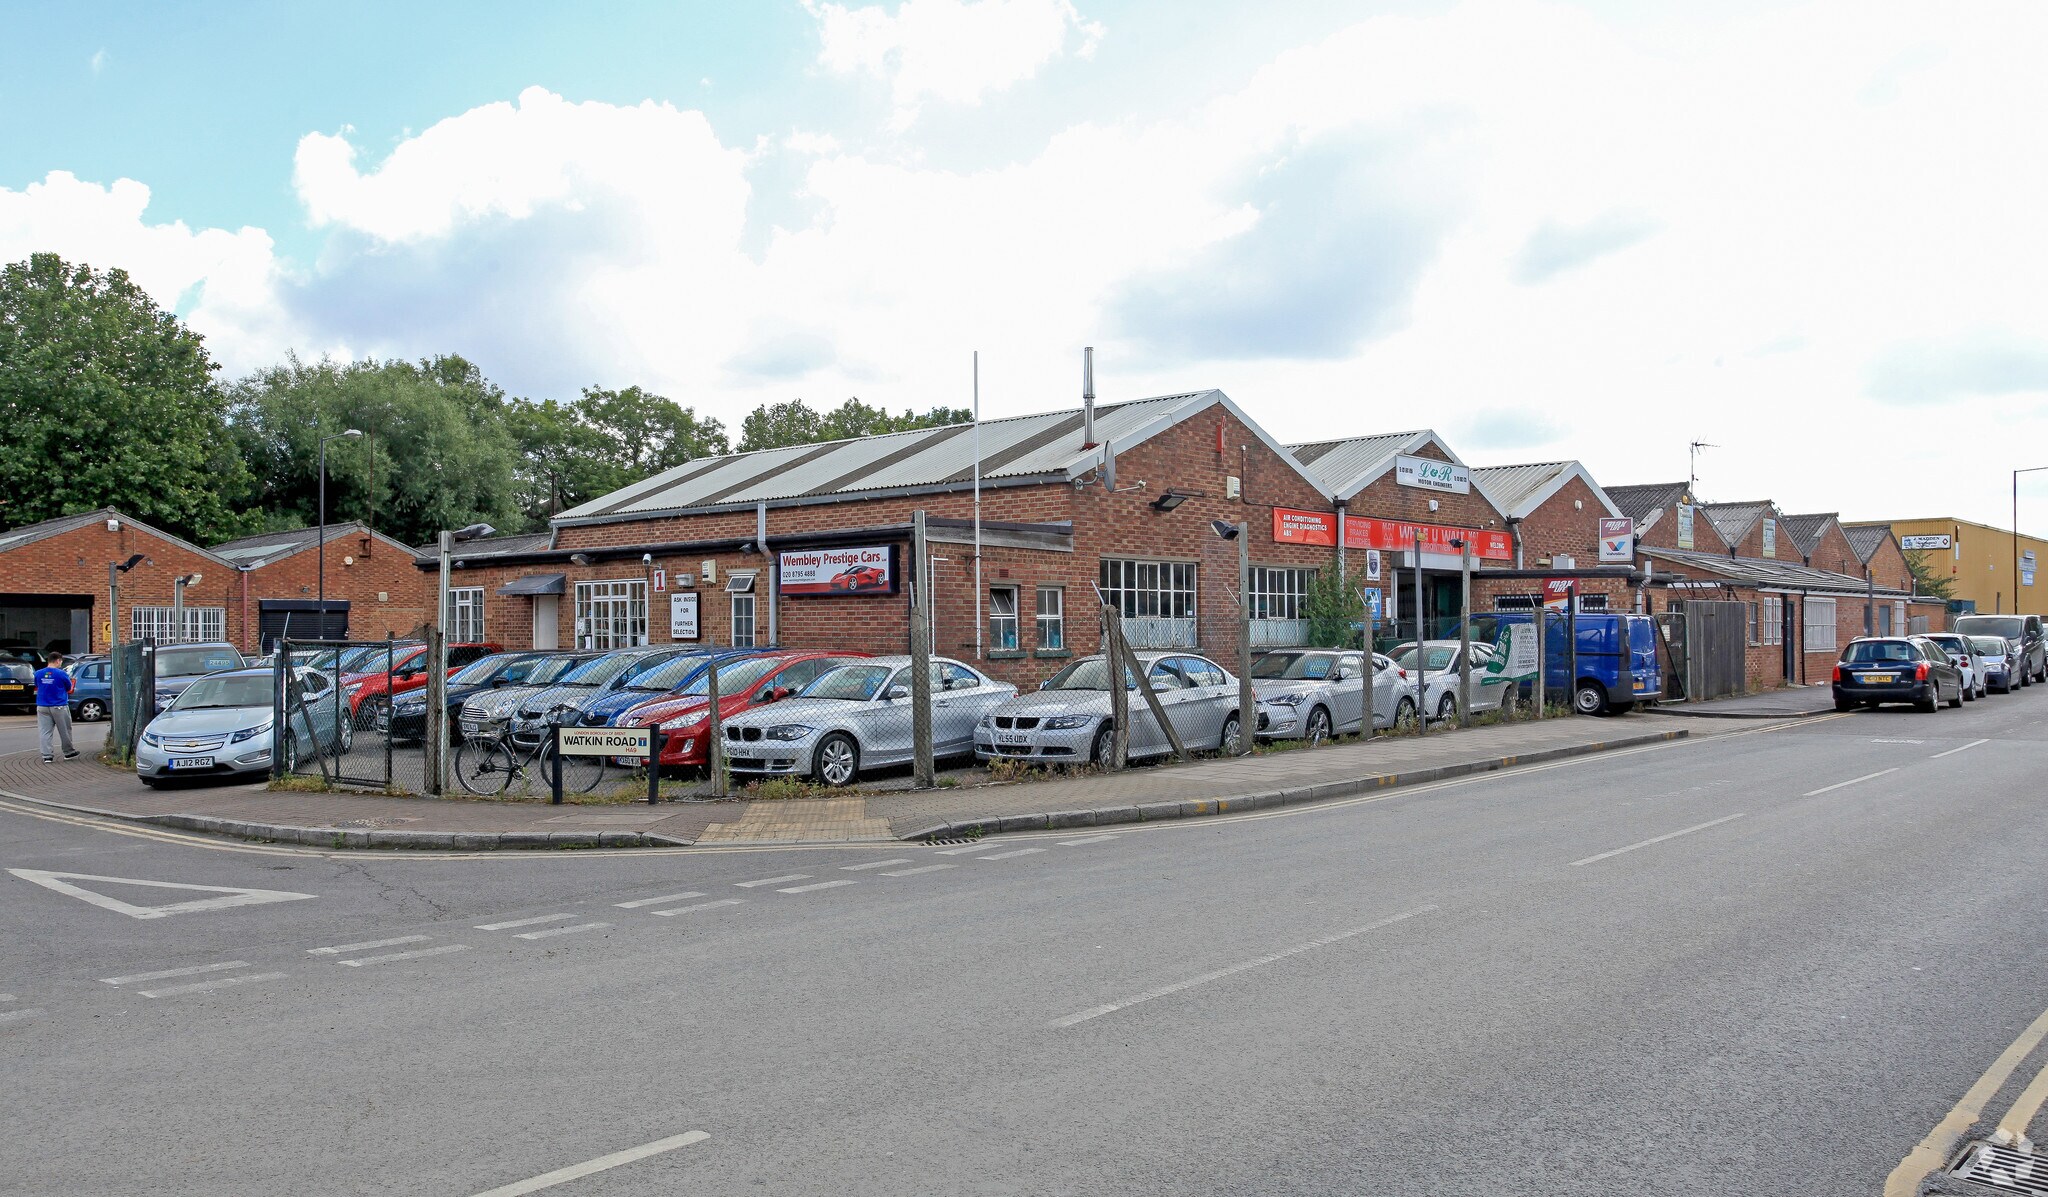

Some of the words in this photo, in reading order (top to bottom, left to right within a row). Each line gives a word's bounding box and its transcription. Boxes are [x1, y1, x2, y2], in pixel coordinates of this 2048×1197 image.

[1417, 478, 1432, 486] MOTOR
[1432, 480, 1453, 489] ENGINEERS
[1291, 514, 1322, 524] CONDITIONING
[1283, 521, 1300, 530] ENGINE
[1299, 523, 1328, 531] DIAGNOSTICS
[1349, 528, 1369, 537] BRAKES
[1399, 525, 1428, 541] WHE
[1432, 529, 1438, 542] U
[1346, 536, 1371, 546] CLUTCHES
[782, 553, 822, 568] Wembley
[823, 551, 859, 566] Prestige
[860, 550, 881, 563] Cars
[655, 571, 665, 591] 1
[564, 736, 603, 746] WATKIN
[606, 736, 637, 747] ROAD
[176, 759, 193, 767] AJ12
[194, 758, 210, 766] RGZ
